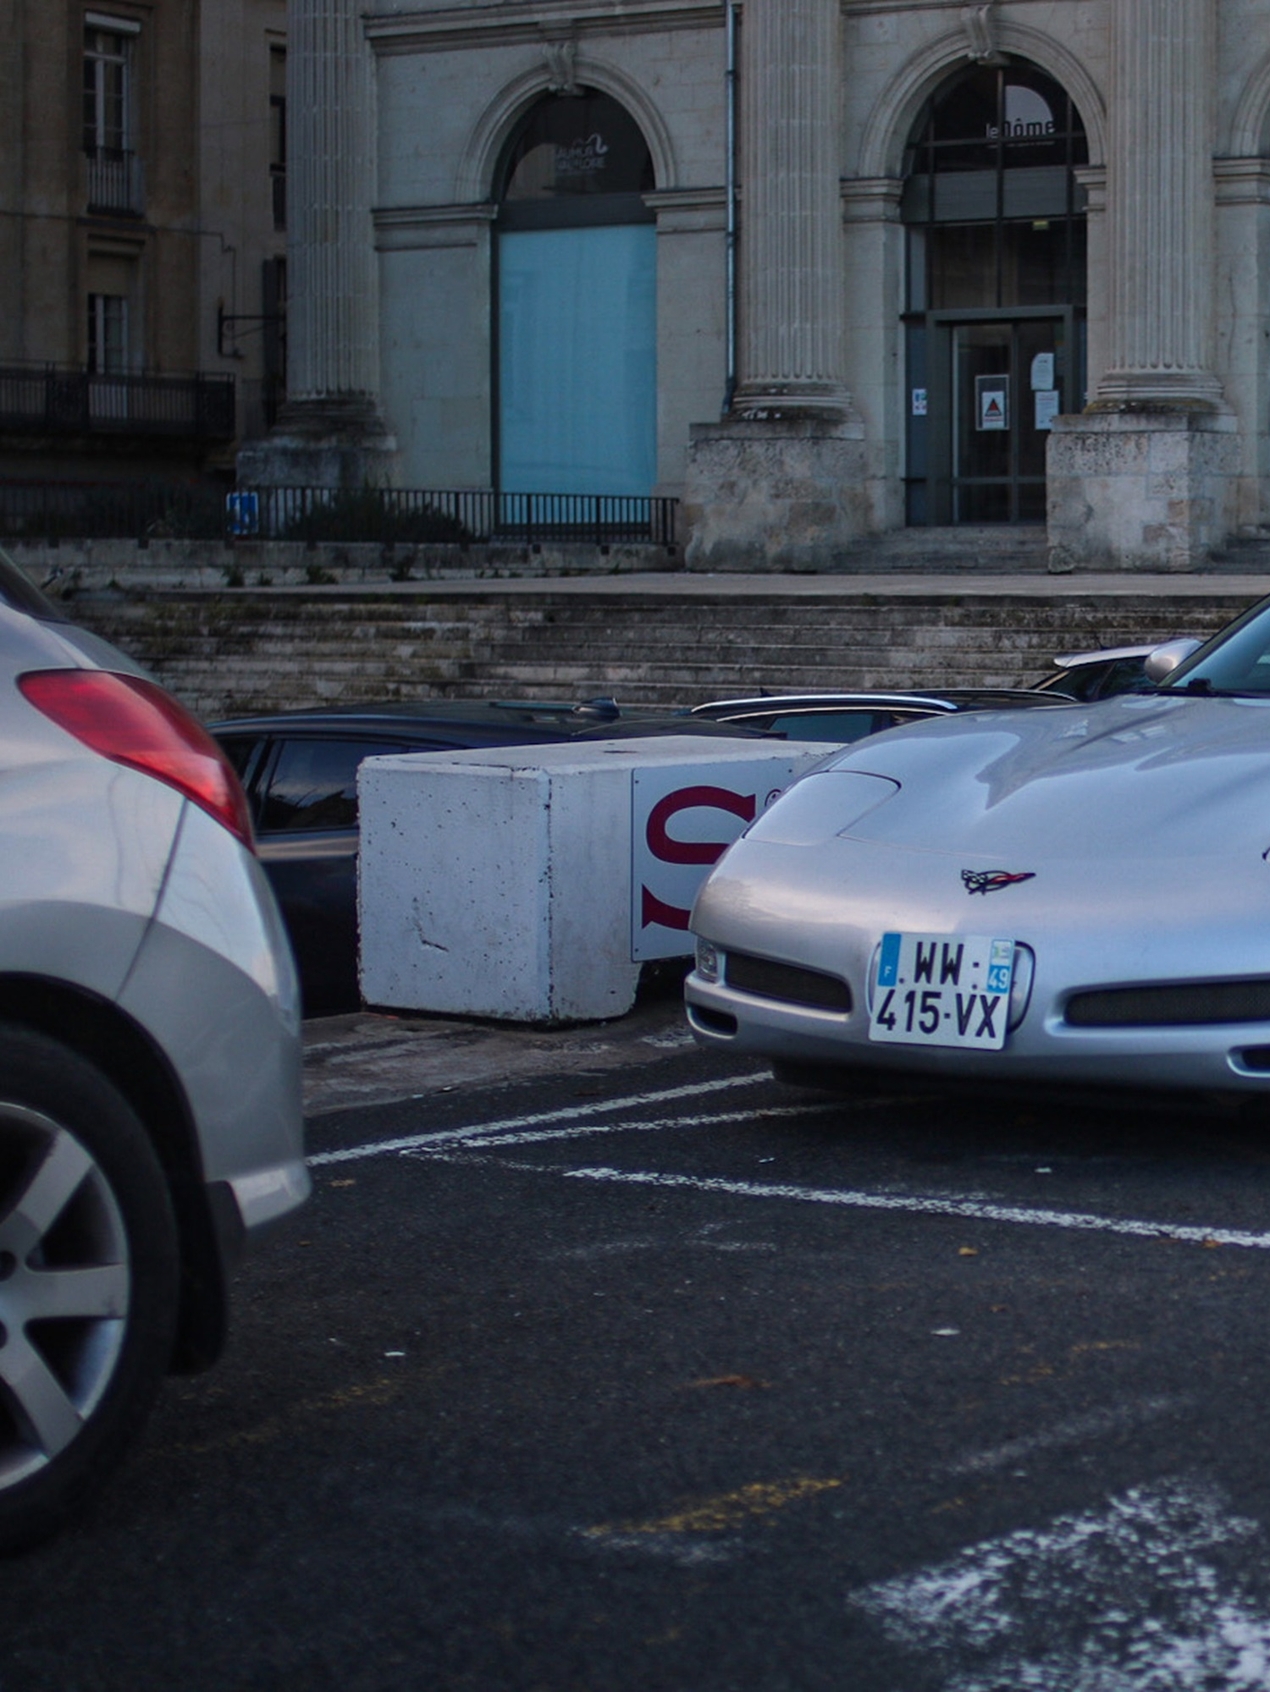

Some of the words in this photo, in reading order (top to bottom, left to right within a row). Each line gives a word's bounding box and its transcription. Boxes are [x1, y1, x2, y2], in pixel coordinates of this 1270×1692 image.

[986, 122, 999, 138] le
[988, 968, 1009, 990] 49
[876, 989, 1001, 1039] 415-VX
